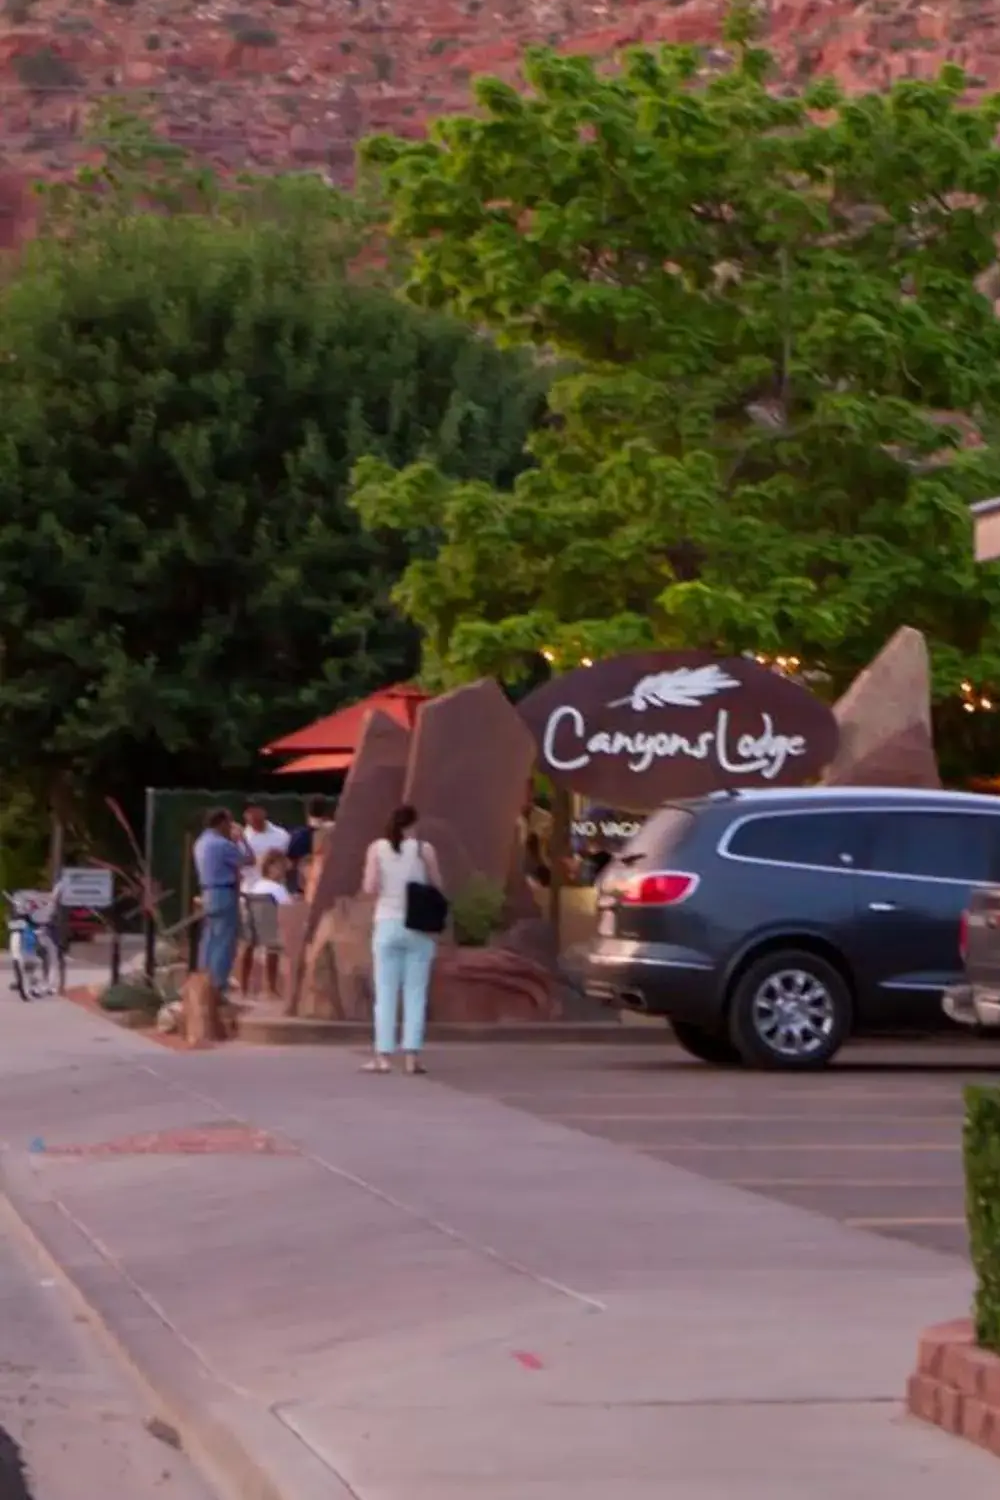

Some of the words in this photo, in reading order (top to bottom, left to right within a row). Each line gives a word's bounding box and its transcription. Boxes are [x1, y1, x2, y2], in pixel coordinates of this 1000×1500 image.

[543, 705, 714, 772] Canyons
[716, 708, 806, 779] Lodge
[570, 820, 598, 837] NO
